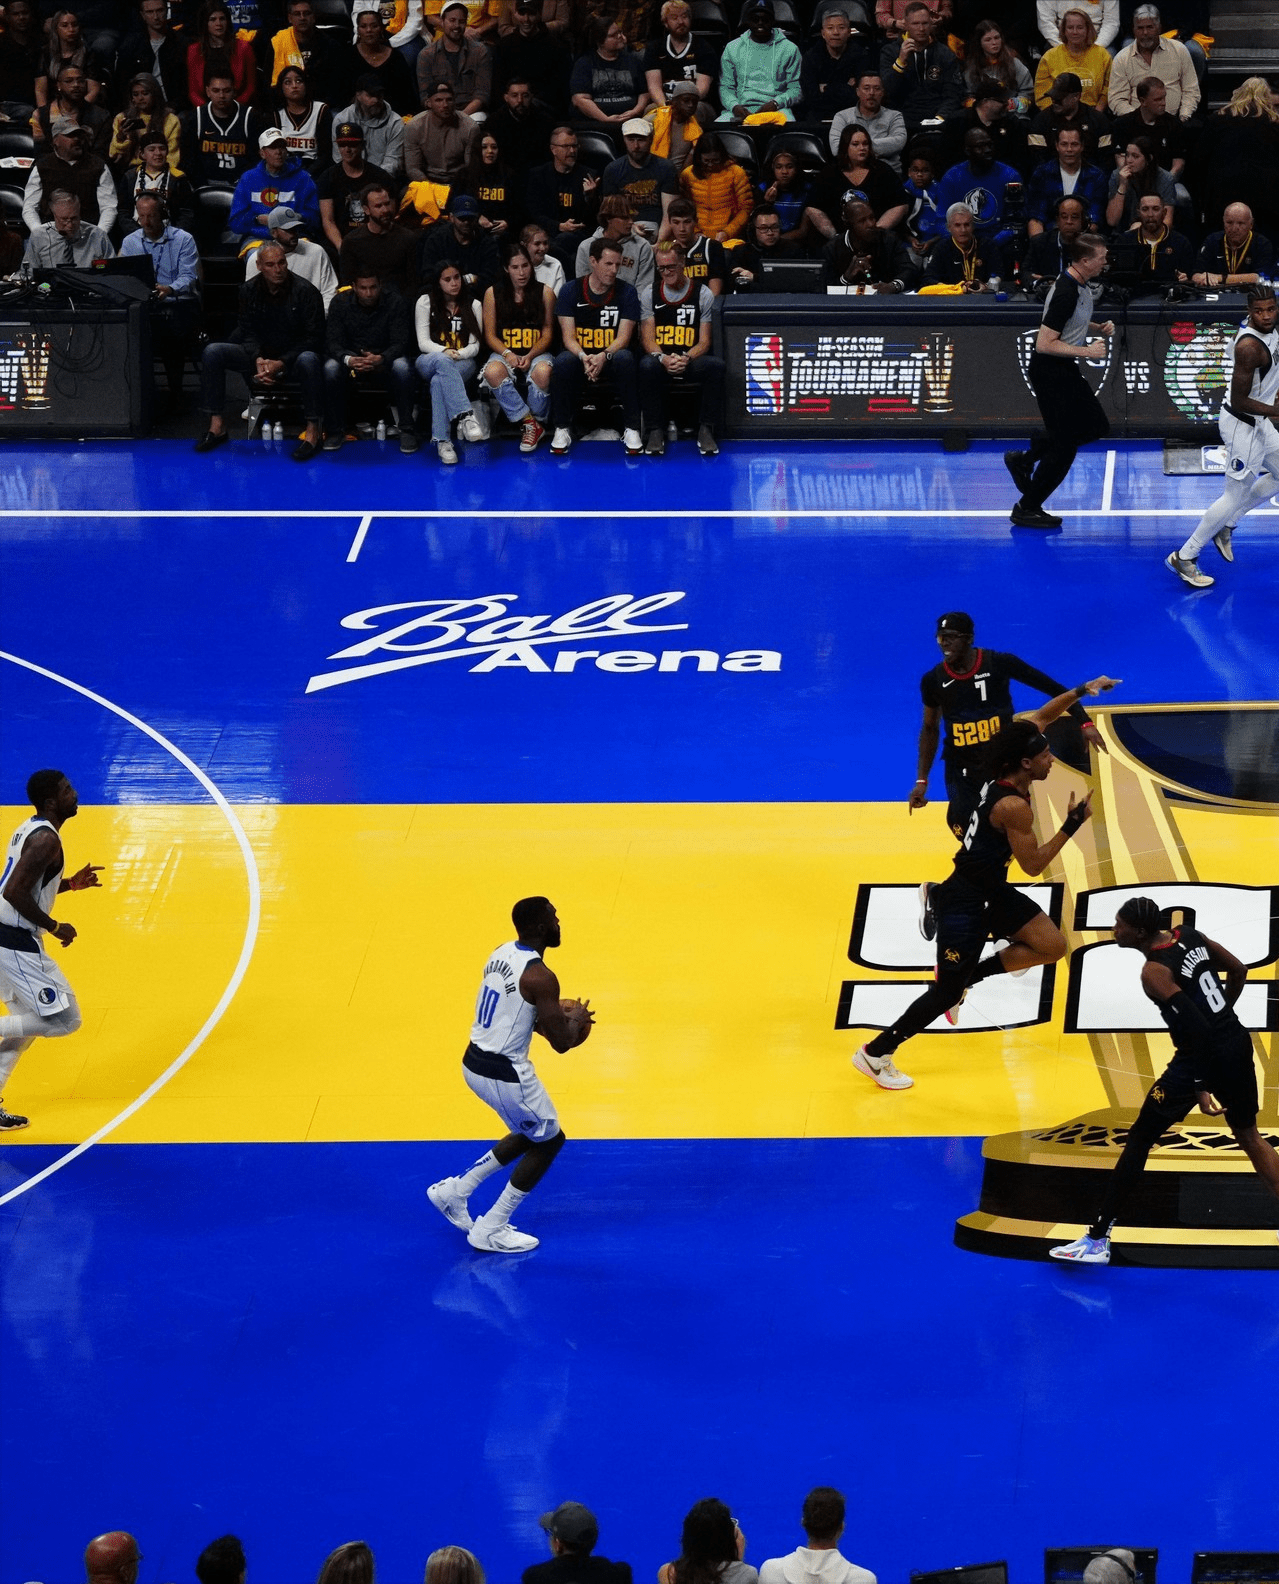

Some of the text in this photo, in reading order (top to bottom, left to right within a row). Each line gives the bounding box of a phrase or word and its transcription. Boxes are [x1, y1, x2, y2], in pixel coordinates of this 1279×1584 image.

[202, 139, 246, 154] DENVER
[286, 136, 315, 149] GGETS
[684, 264, 708, 278] VER
[600, 309, 619, 327] 27
[676, 308, 696, 325] 27
[576, 328, 615, 348] 5280
[656, 325, 695, 347] 5280
[817, 336, 884, 358] IN-SEASON
[787, 352, 929, 405] TOURNAMENT
[1123, 361, 1150, 394] VS
[320, 591, 688, 668] Ball
[468, 645, 782, 673] Arena
[974, 680, 987, 701] 7
[952, 715, 1001, 747] 5280
[1181, 946, 1210, 979] WATSON
[1198, 969, 1226, 1014] 8
[478, 985, 500, 1029] 10
